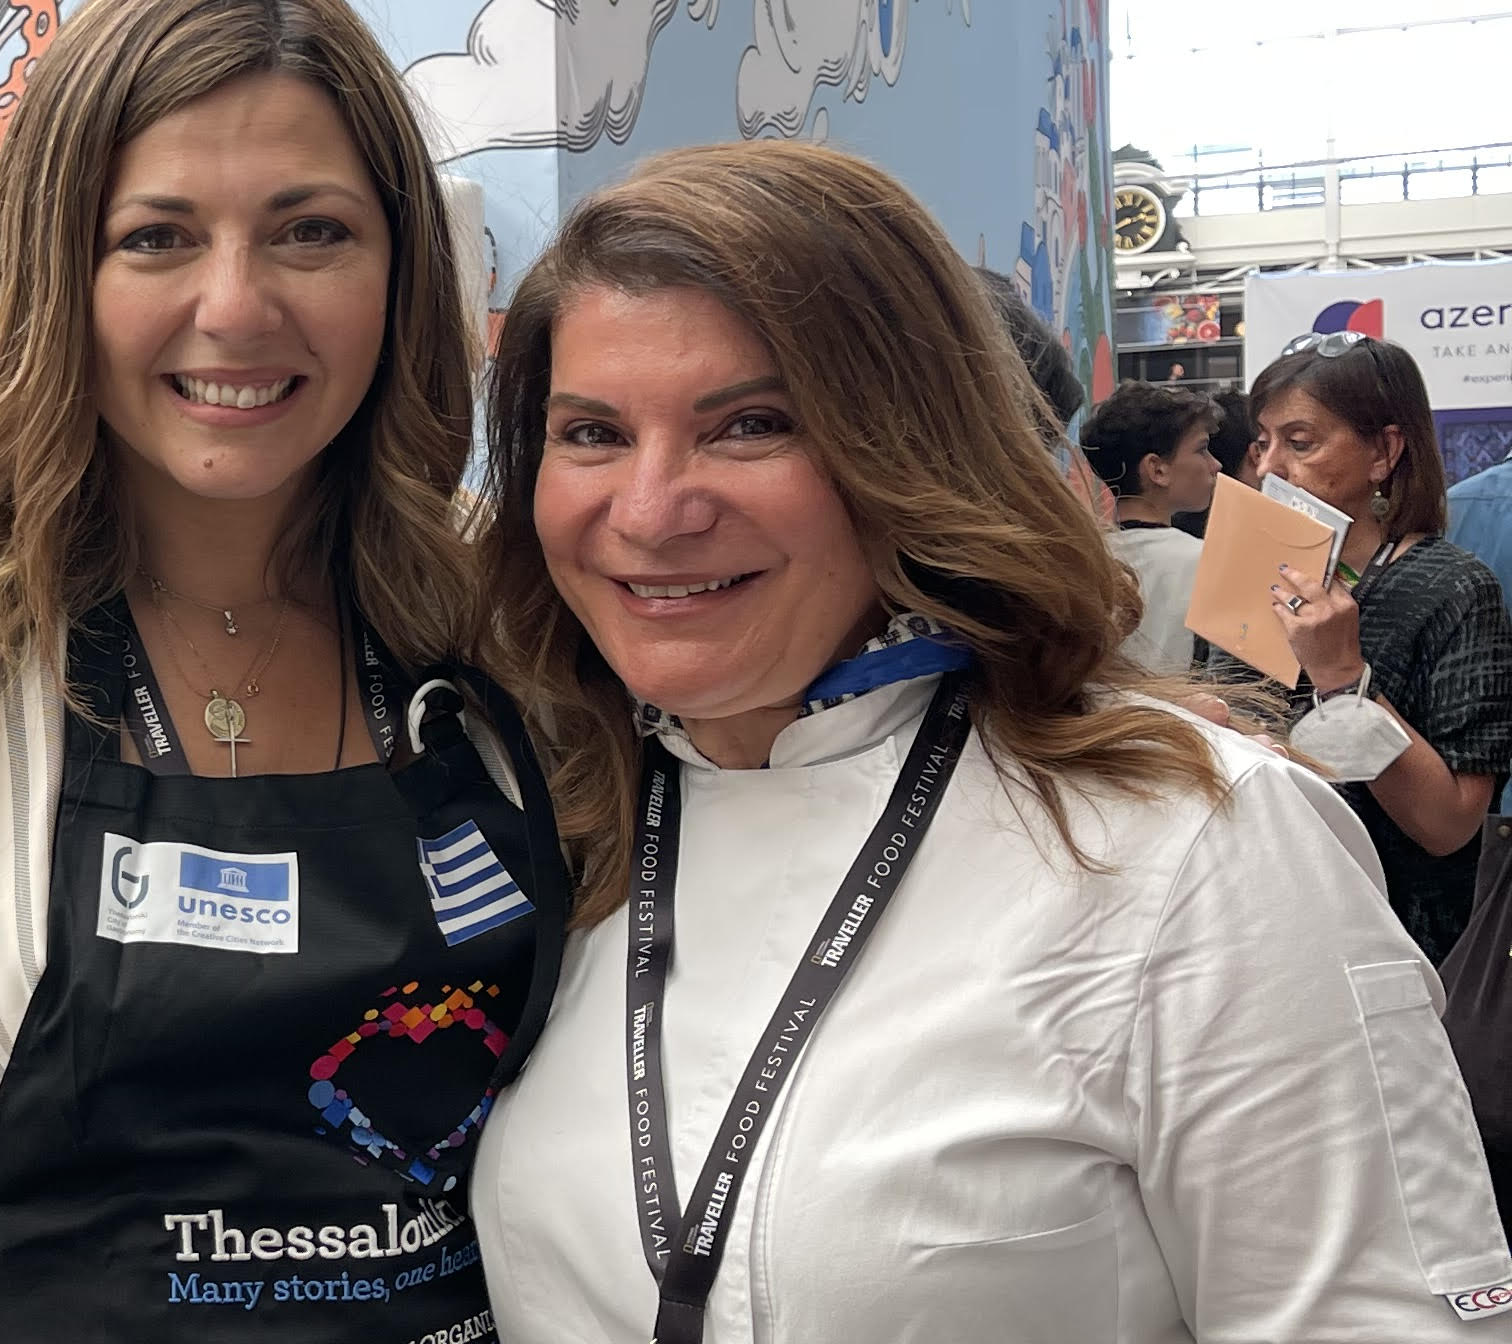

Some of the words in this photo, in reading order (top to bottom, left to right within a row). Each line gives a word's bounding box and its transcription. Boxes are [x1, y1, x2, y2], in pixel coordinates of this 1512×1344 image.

[1432, 344, 1477, 358] TAKE
[134, 685, 172, 756] TRAVELLER
[369, 674, 387, 719] FOOD
[645, 769, 666, 827] TRAVELLER
[640, 833, 660, 882] FOOD
[820, 894, 875, 968] TRAVELLER
[867, 832, 907, 889] FOOD
[901, 744, 949, 828] FESTIVAL
[178, 895, 291, 925] unesco
[635, 890, 655, 978] FESTIVAL
[633, 1005, 646, 1081] TRAVELLER
[635, 1088, 651, 1147] FOOD
[693, 1171, 734, 1257] TRAVELLER
[726, 1100, 761, 1163] FOOD
[755, 997, 817, 1092] FESTIVAL
[640, 1156, 672, 1260] FESTIVAL
[168, 1272, 264, 1311] Many
[273, 1272, 390, 1303] stories,
[395, 1262, 436, 1291] one
